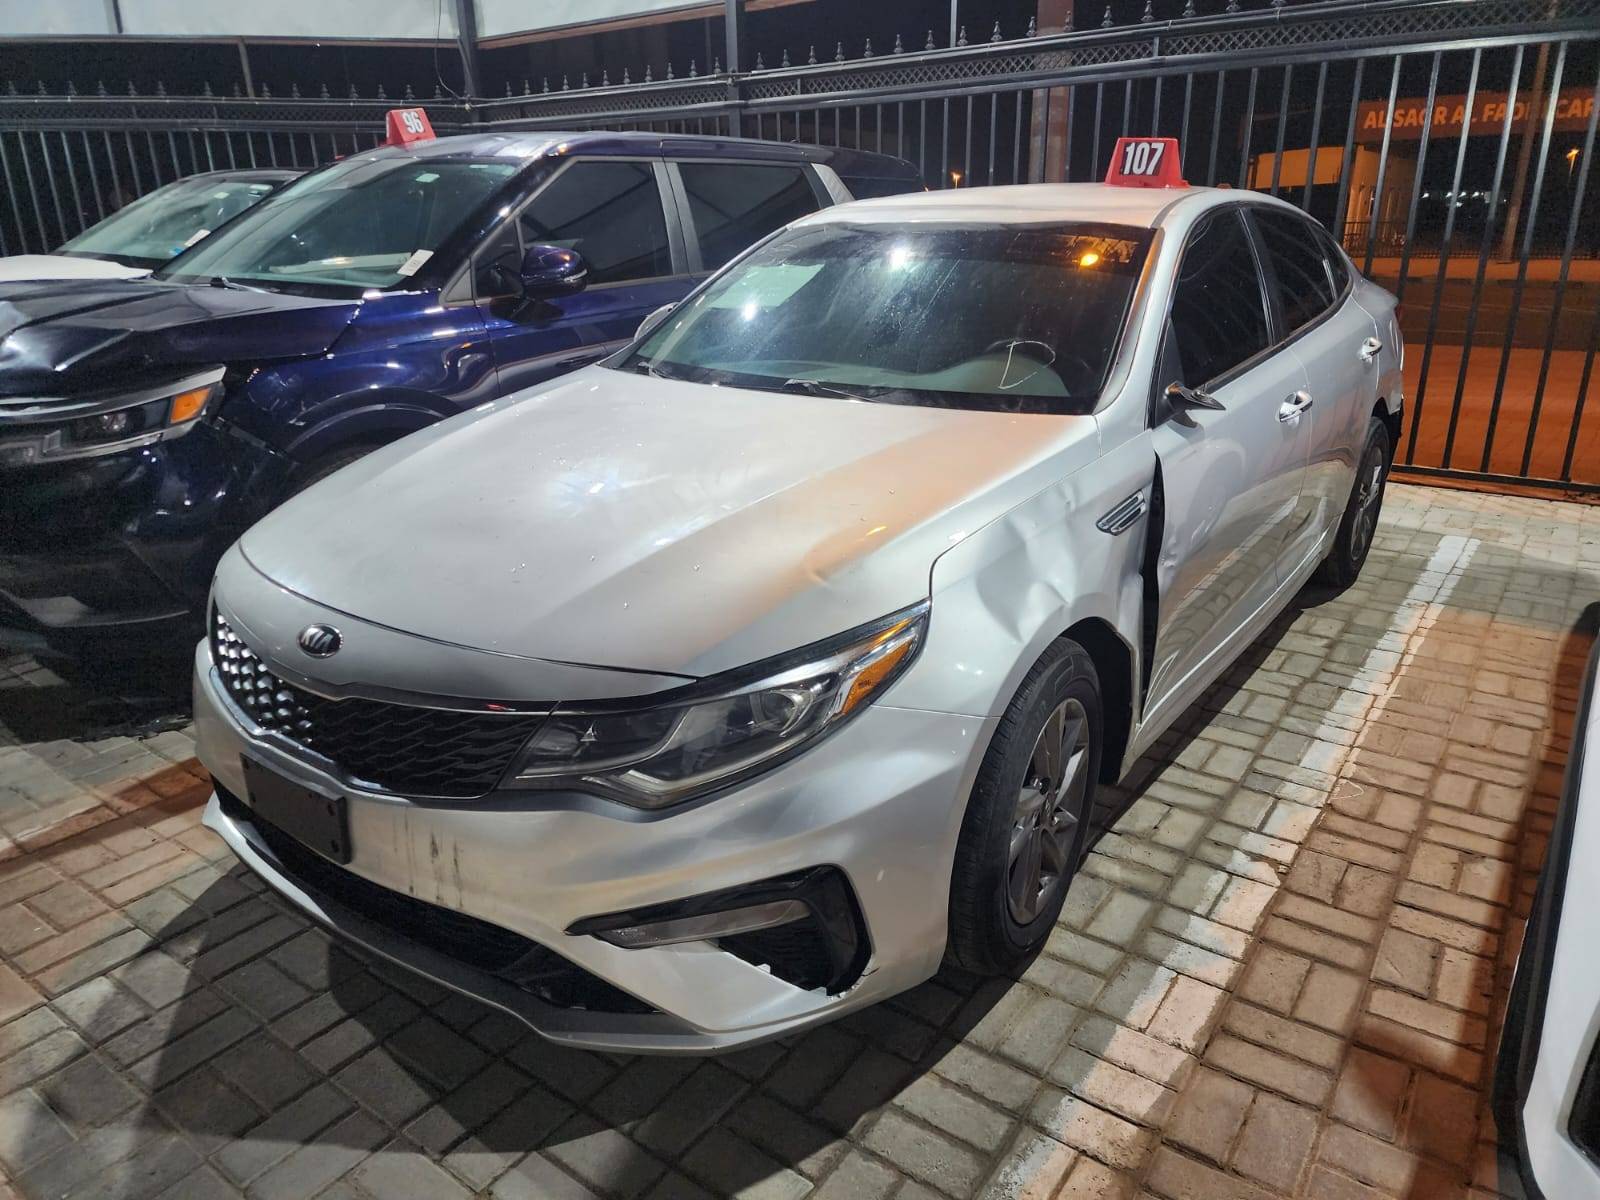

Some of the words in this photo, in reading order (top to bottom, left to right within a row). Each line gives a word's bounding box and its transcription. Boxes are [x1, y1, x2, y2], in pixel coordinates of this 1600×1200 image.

[402, 111, 425, 134] 96
[1450, 104, 1478, 124] A
[1122, 141, 1165, 176] 107
[299, 626, 337, 651] KIA
